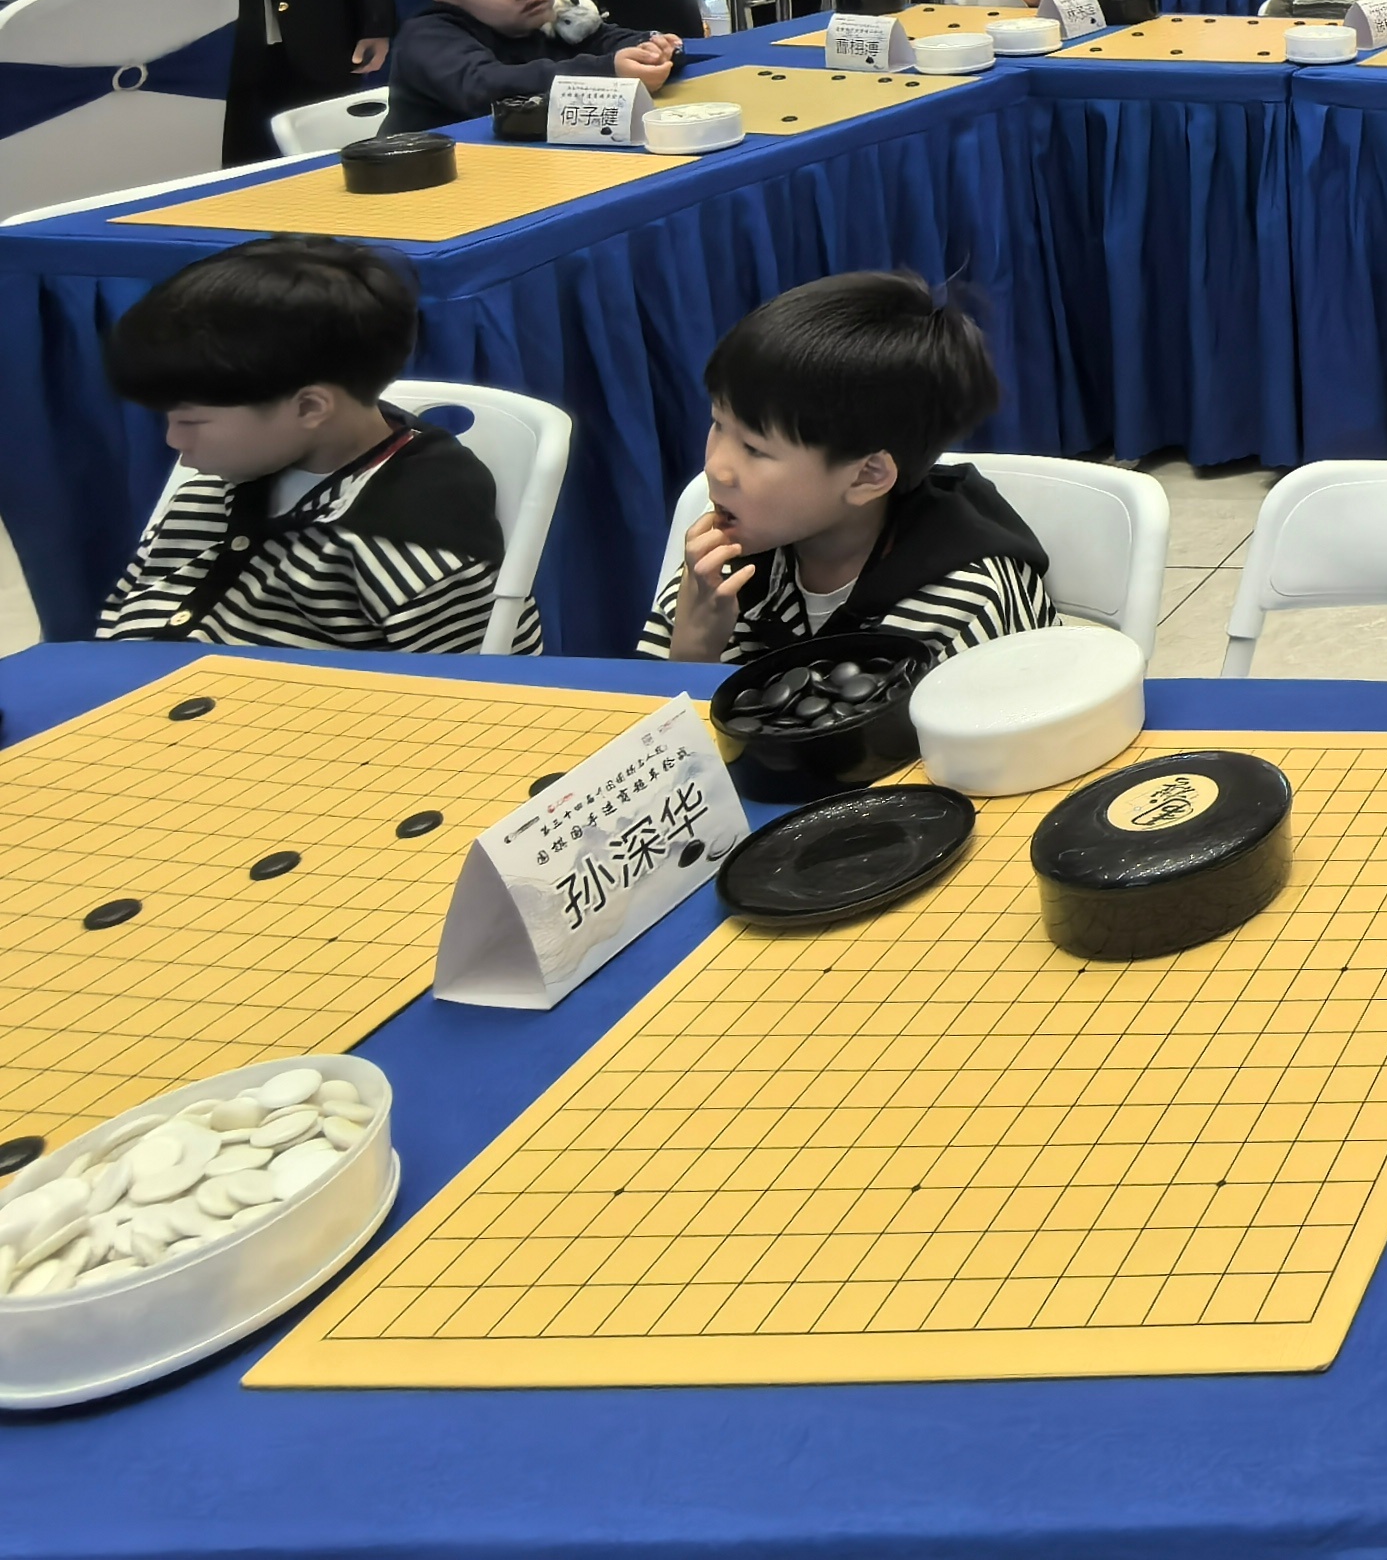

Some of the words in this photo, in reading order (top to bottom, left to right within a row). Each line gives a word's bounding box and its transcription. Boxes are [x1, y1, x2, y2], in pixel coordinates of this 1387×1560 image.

[560, 104, 620, 127] 何子健
[555, 781, 710, 931] 孙深华
